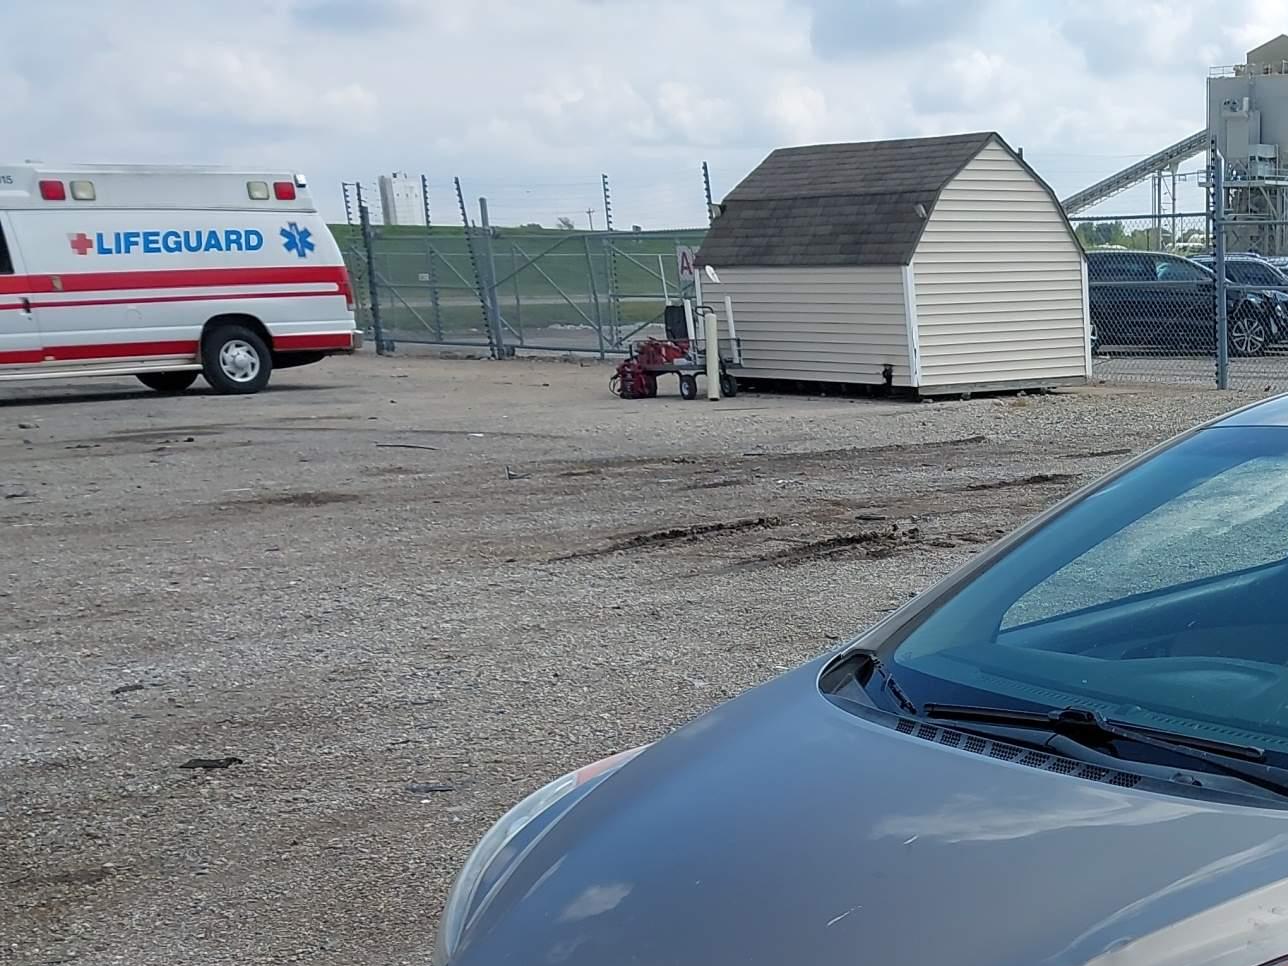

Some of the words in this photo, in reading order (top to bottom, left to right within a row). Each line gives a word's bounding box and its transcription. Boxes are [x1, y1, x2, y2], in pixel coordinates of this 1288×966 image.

[0, 175, 14, 184] 15
[96, 229, 264, 255] LIFEGUARD
[681, 251, 693, 275] A
